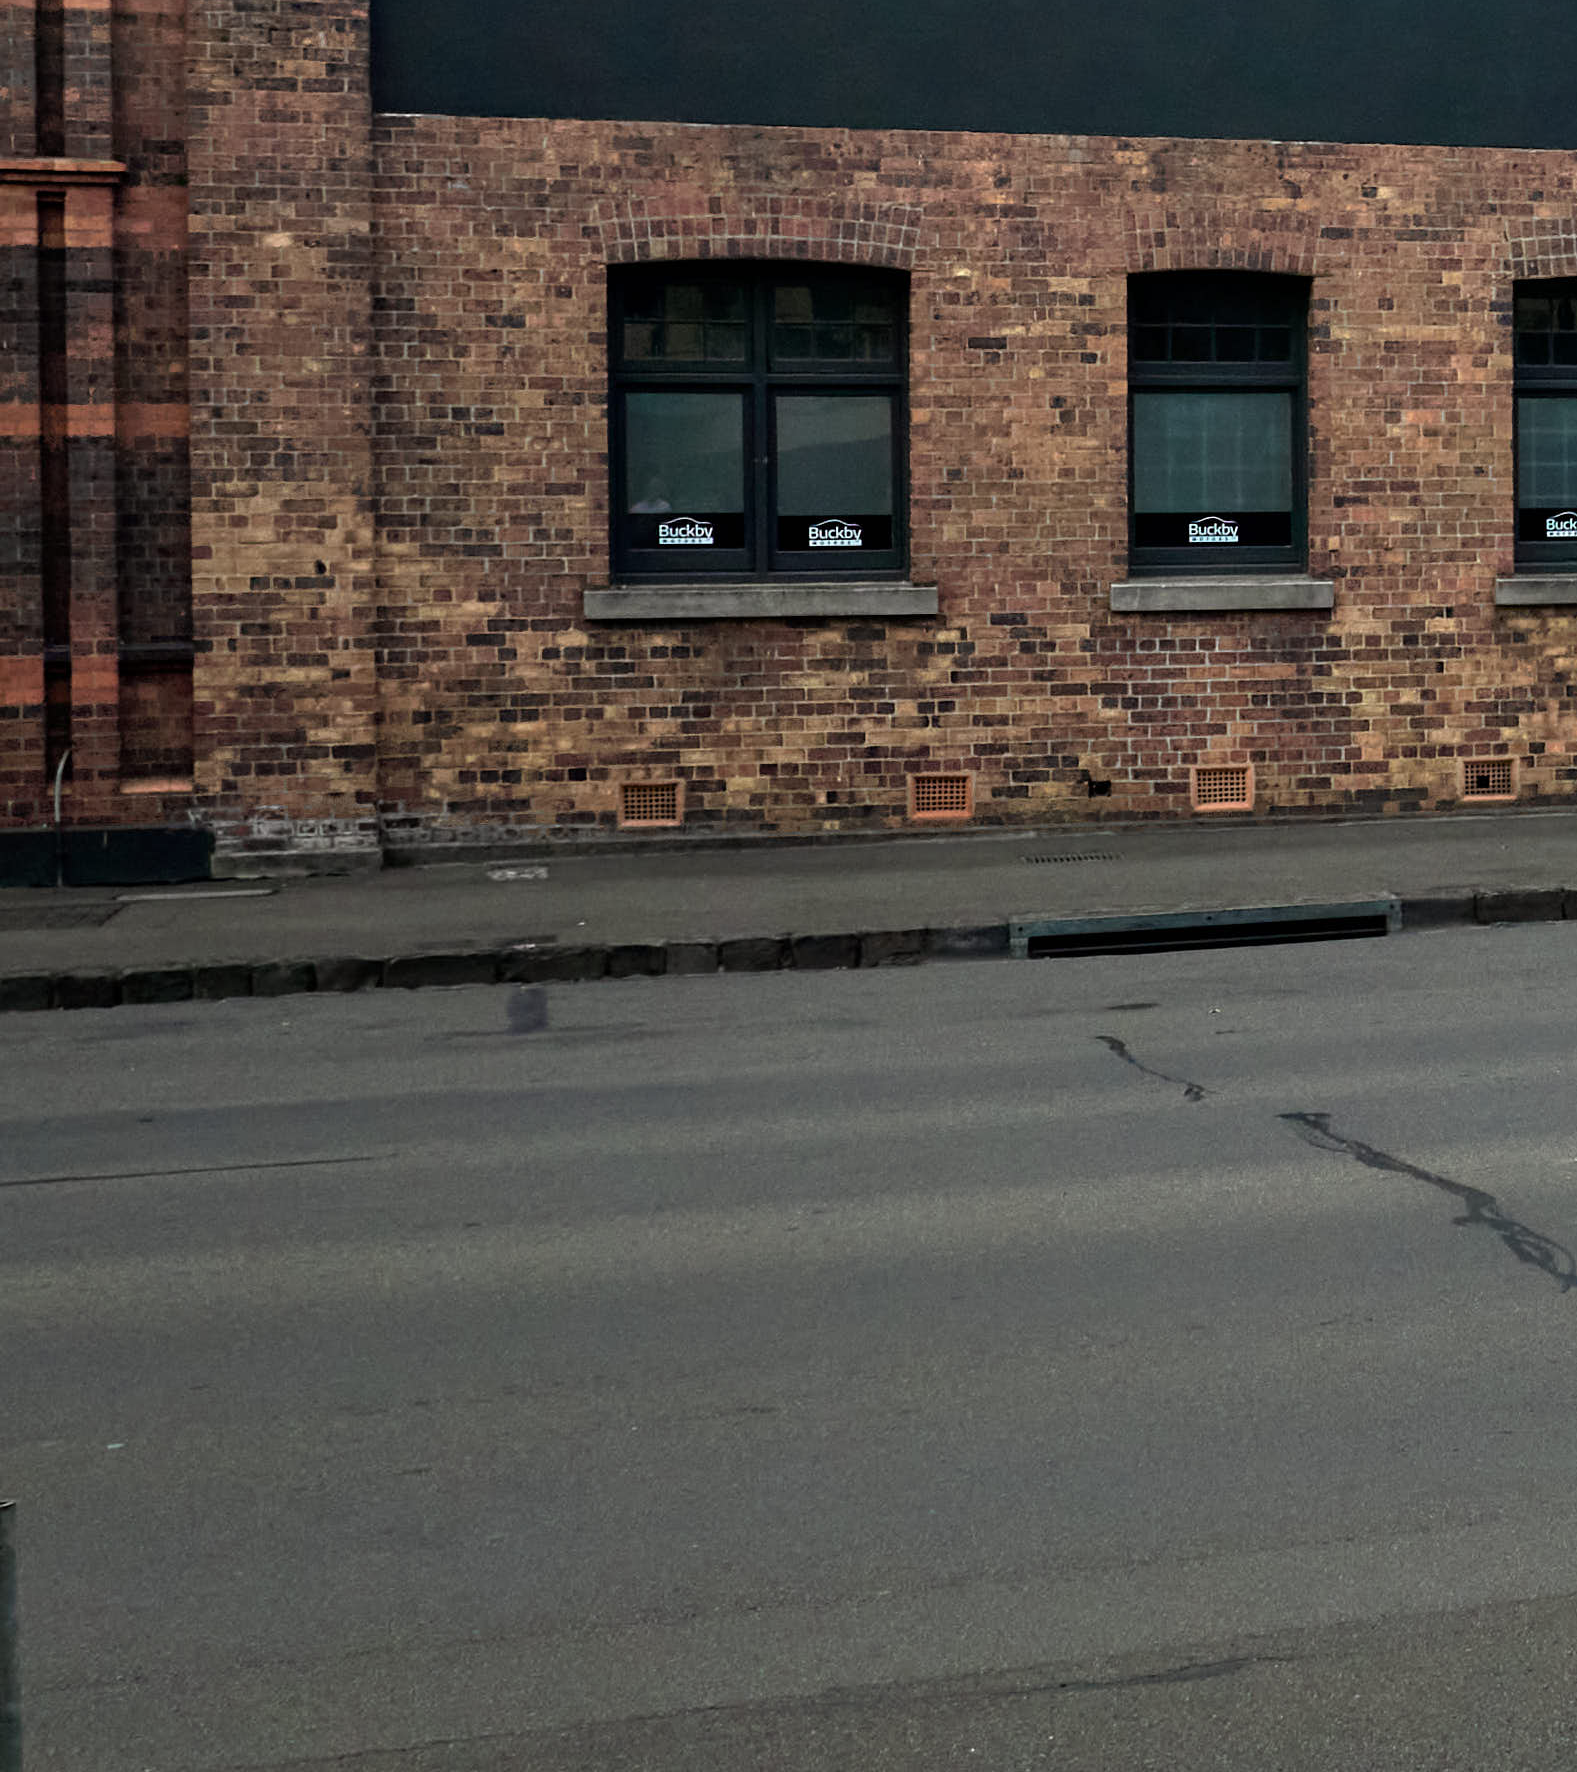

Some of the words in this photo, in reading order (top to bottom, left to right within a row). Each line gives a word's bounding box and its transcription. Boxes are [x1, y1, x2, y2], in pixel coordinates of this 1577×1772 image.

[659, 524, 713, 539] Buckby
[809, 526, 862, 540] Buckby
[1189, 523, 1238, 537] Buckby
